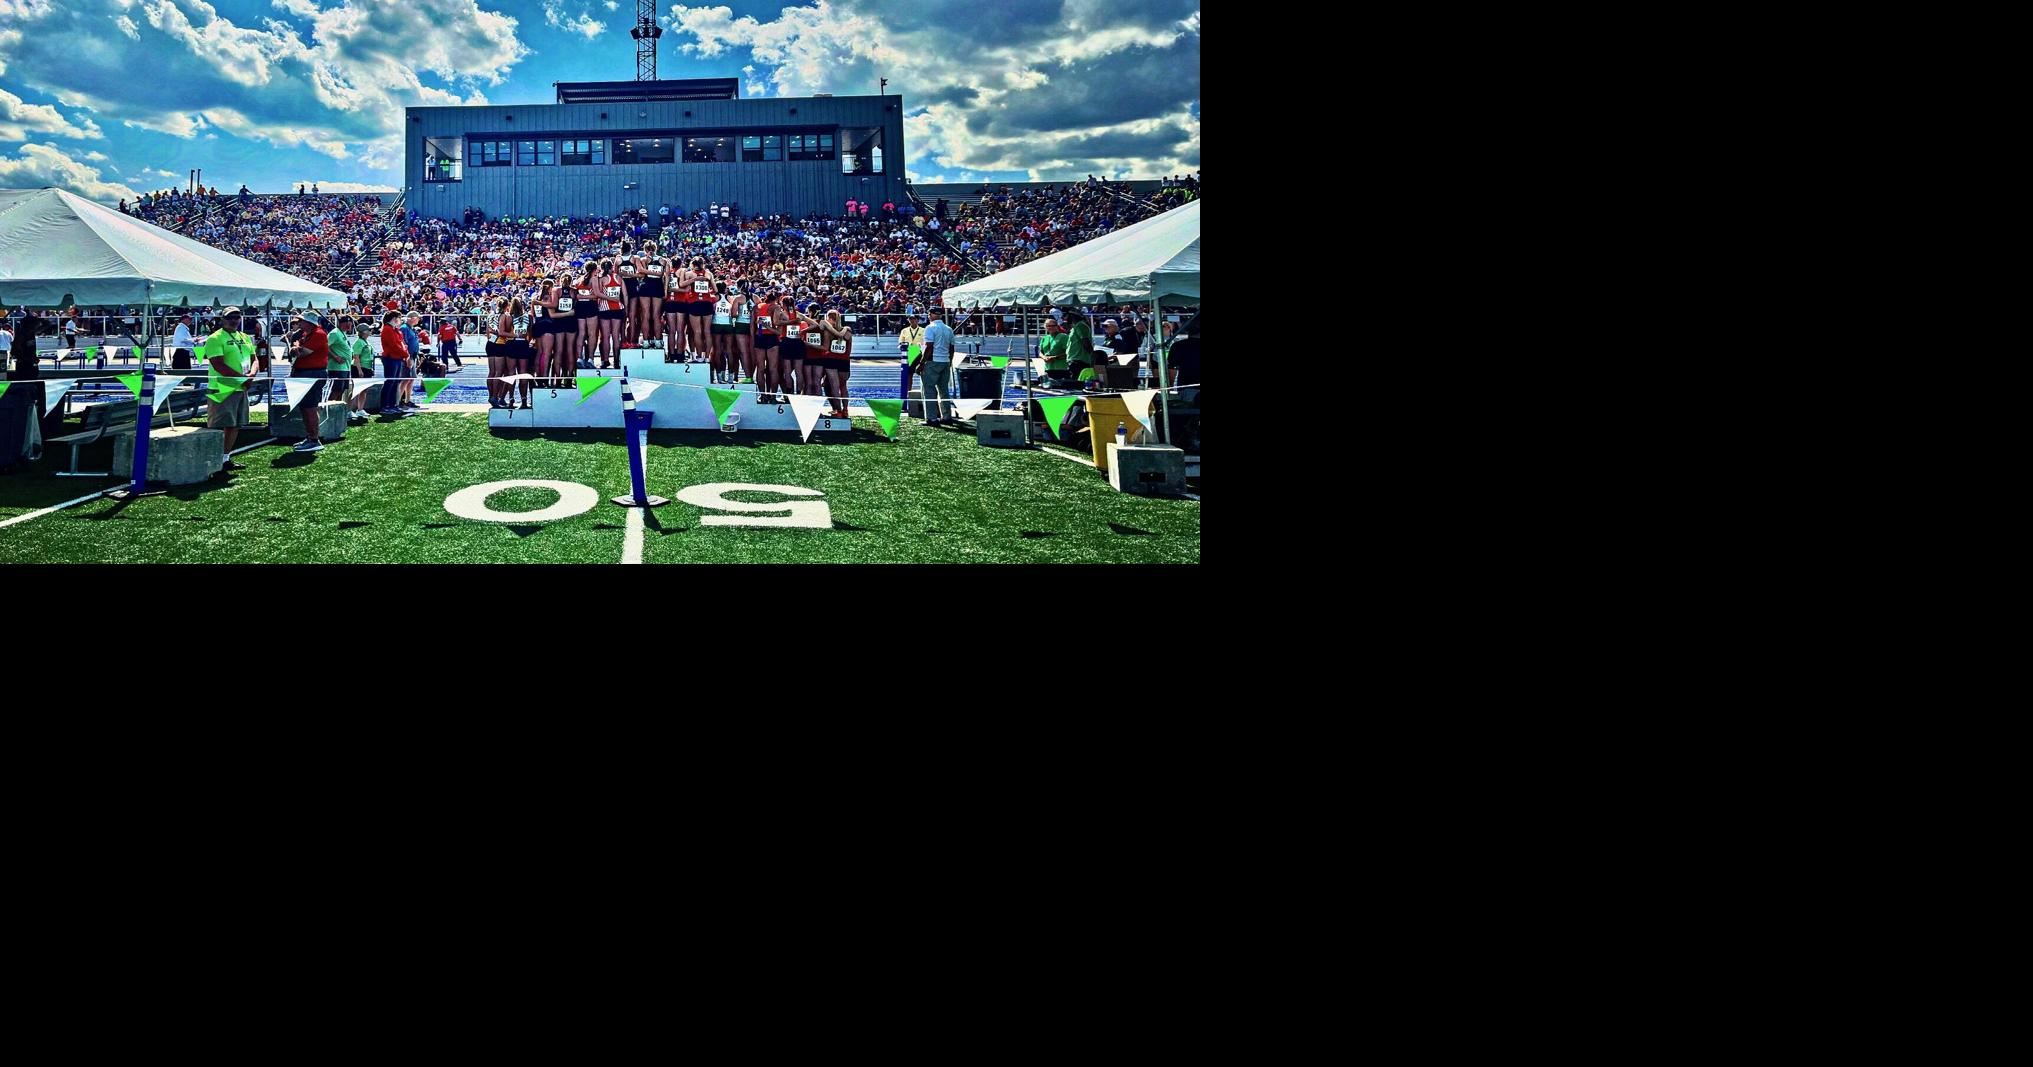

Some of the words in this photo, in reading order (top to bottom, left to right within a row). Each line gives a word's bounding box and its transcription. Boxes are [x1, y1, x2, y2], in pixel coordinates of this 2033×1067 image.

[684, 363, 691, 374] 2
[550, 389, 558, 399] 5
[507, 409, 514, 419] 7
[777, 404, 785, 415] 6
[824, 419, 832, 429] 8
